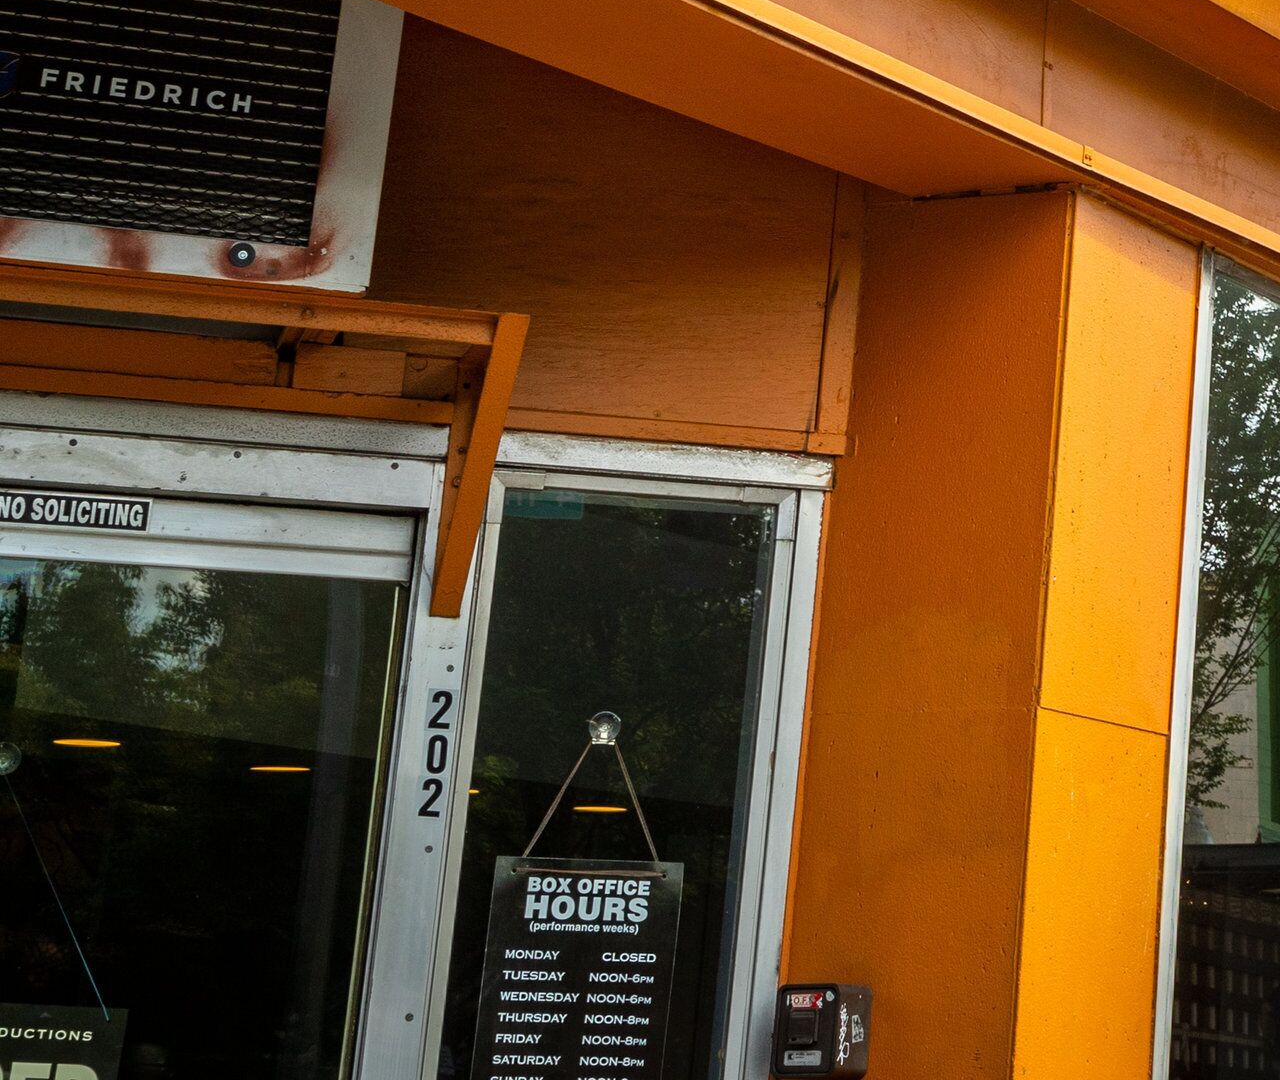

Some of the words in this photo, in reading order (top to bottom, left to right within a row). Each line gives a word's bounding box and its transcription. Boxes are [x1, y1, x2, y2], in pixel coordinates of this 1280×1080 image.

[40, 68, 252, 114] FRIEDRICH
[0, 496, 26, 520] NO
[30, 497, 144, 527] SOLICITING
[418, 690, 453, 818] 202
[527, 877, 571, 894] BOX
[577, 878, 650, 896] OFFICE
[524, 894, 649, 922] HOURS
[529, 921, 600, 933] (performance
[602, 923, 639, 935] weeks)
[505, 949, 560, 960] MONDAY
[602, 952, 657, 963] CLOSED
[503, 970, 565, 981] TUESDAY
[500, 991, 579, 1003] WEDNESDAY
[498, 1012, 568, 1024] THURSDAY
[495, 1033, 542, 1044] FRIDAY
[492, 1055, 561, 1066] SATURDAY
